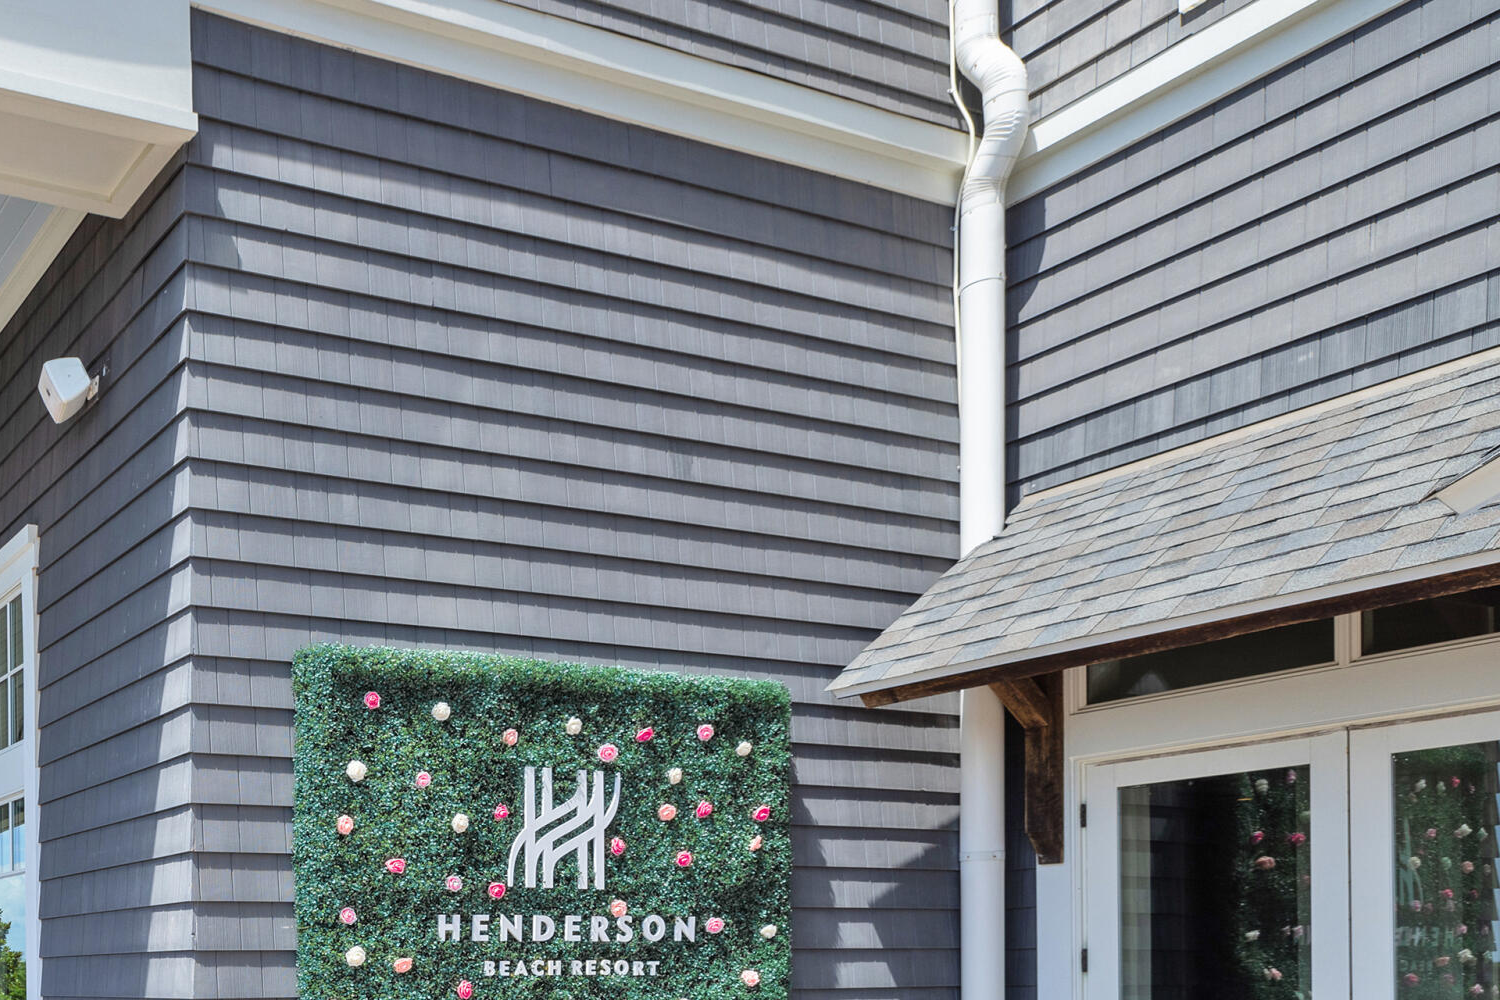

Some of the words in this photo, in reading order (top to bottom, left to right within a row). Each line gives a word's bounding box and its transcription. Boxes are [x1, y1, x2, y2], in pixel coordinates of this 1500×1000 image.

[437, 913, 696, 943] HENDERSON
[483, 959, 562, 977] BEACH
[571, 959, 660, 977] RESORT
